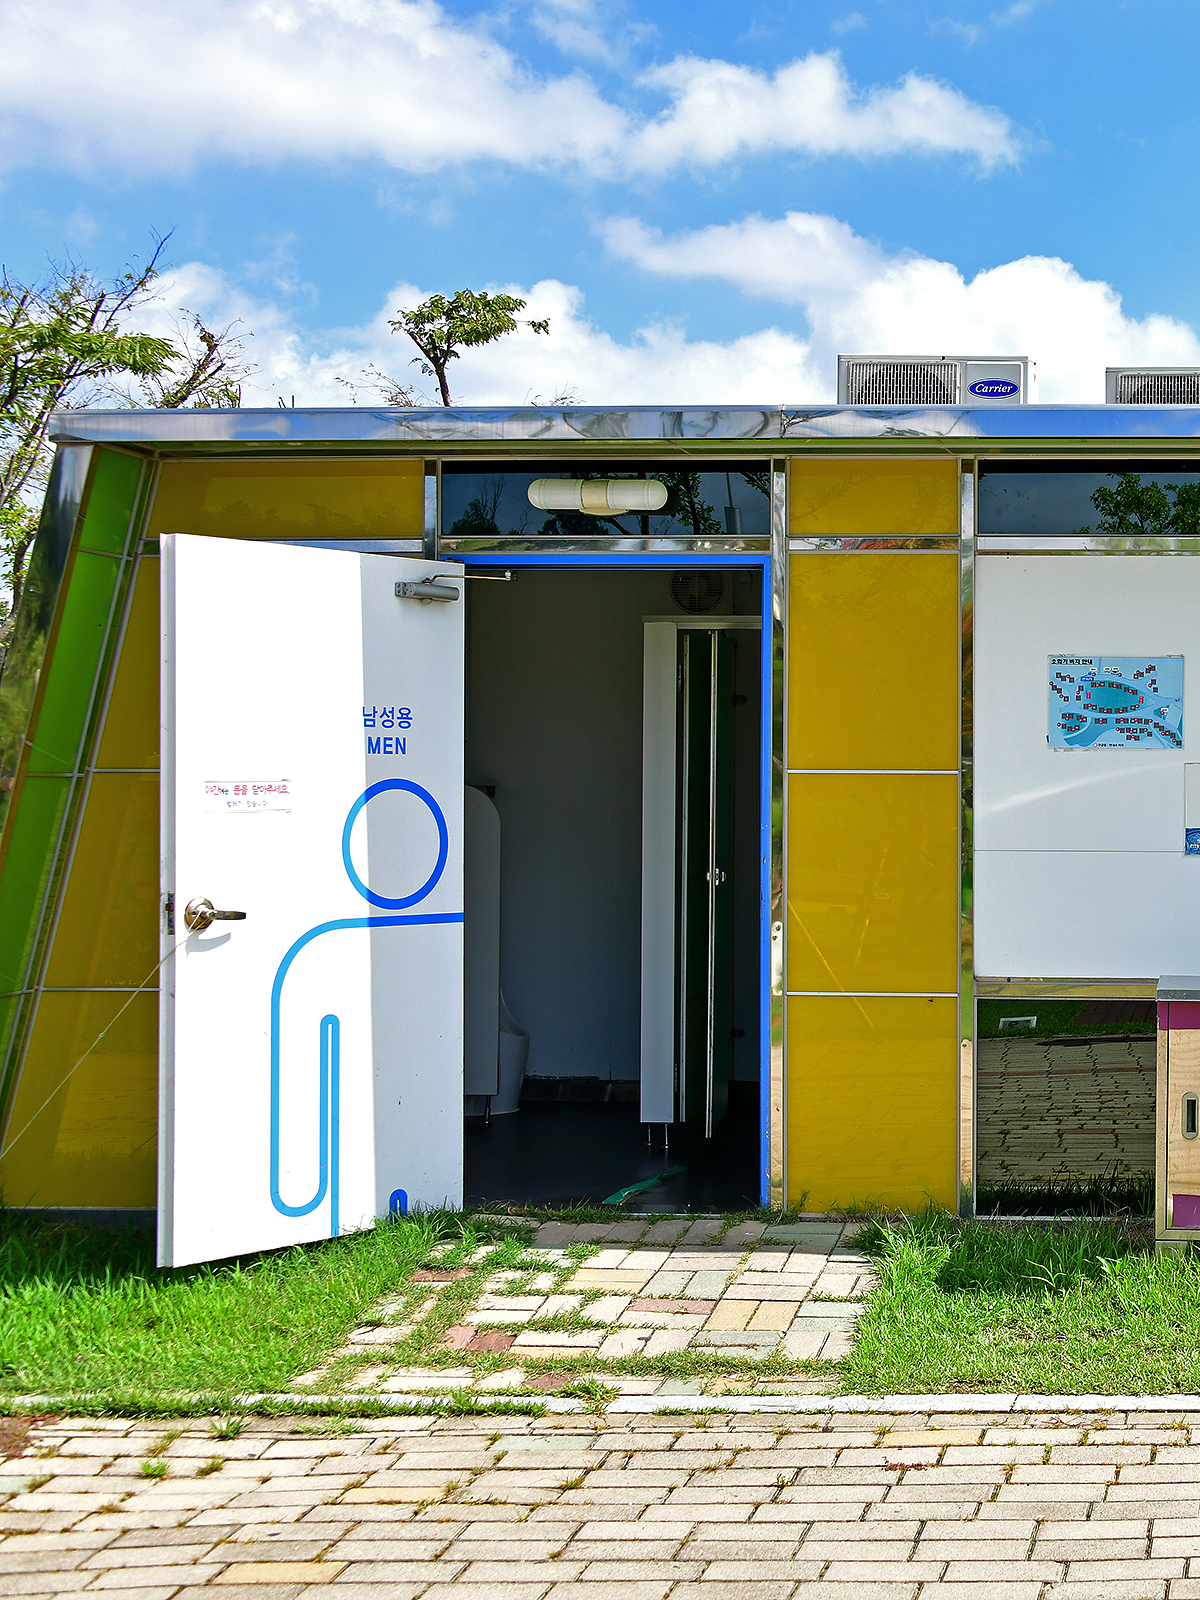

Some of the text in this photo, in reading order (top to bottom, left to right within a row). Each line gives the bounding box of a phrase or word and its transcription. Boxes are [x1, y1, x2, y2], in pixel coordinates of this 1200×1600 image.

[975, 383, 1013, 393] Carrier
[362, 706, 414, 730] 남성용
[367, 736, 408, 755] MEN
